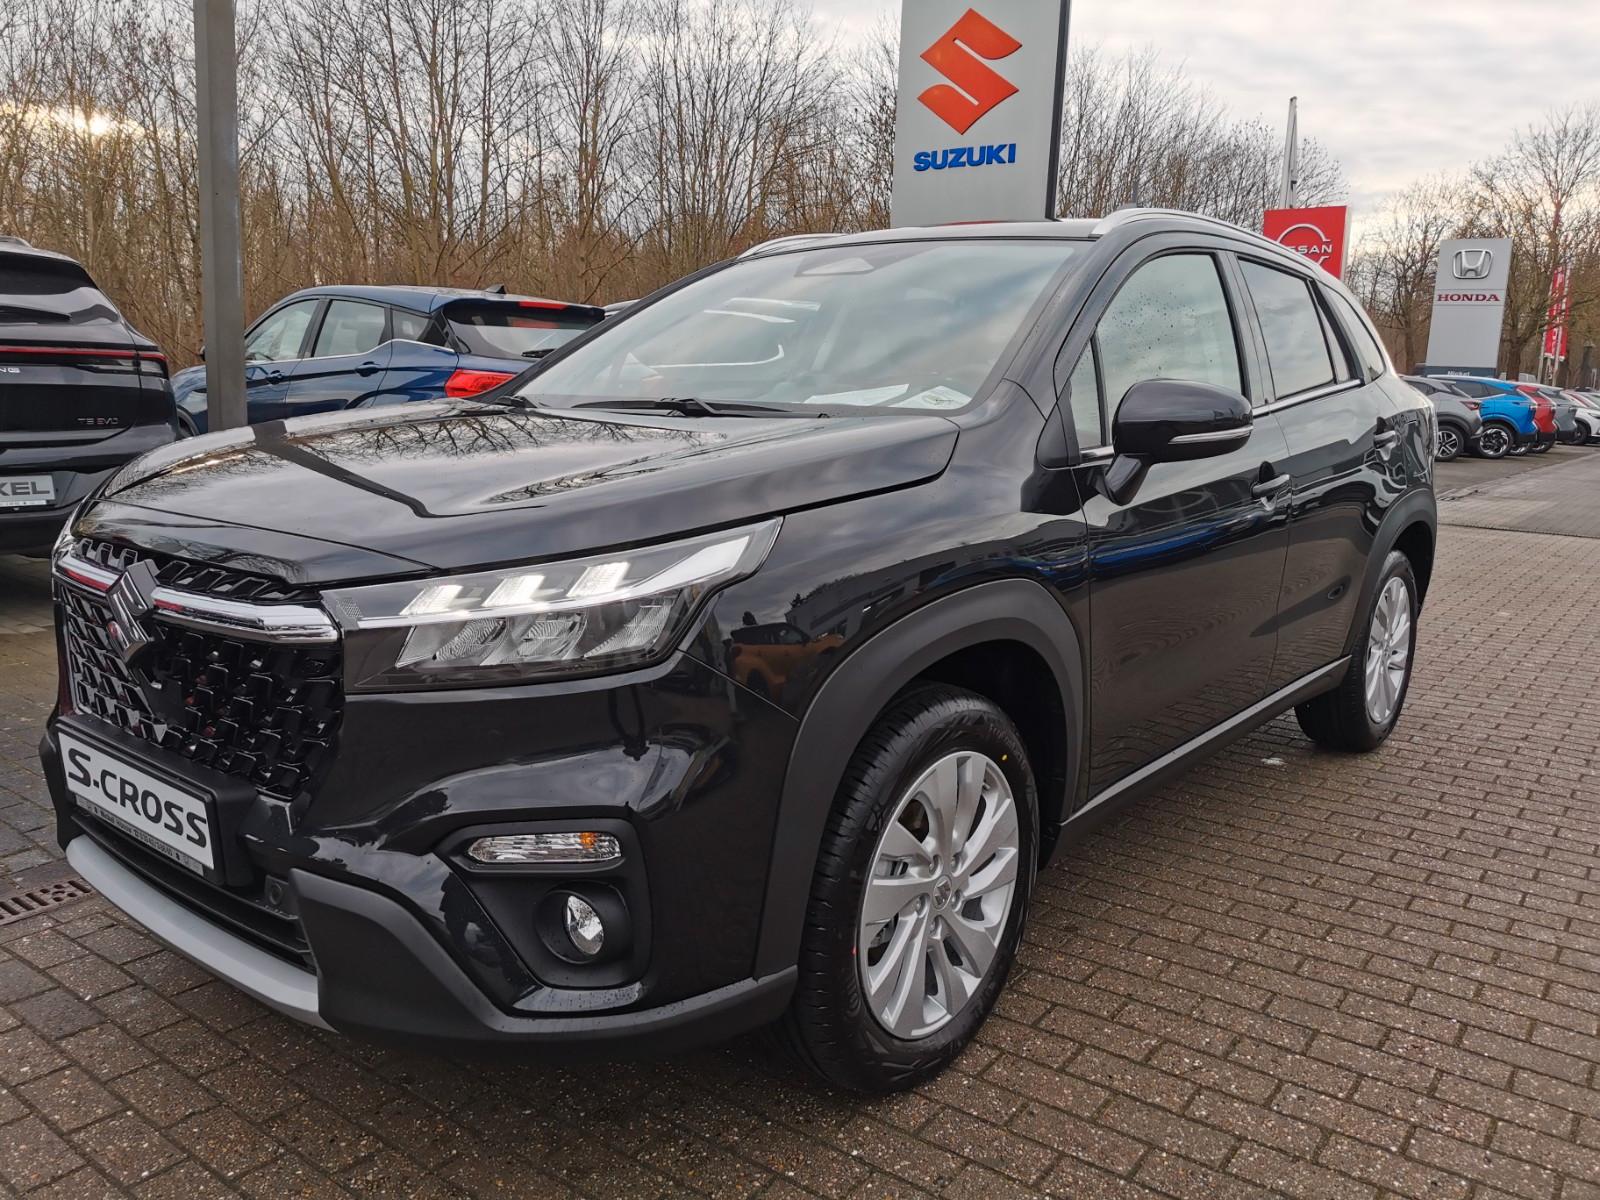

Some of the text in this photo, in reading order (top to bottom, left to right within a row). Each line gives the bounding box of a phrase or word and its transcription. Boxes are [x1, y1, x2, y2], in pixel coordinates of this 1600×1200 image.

[914, 143, 1016, 172] SUZUKI
[1437, 293, 1501, 302] HONDA
[97, 417, 119, 425] EVO
[68, 748, 207, 848] S.CROSS
